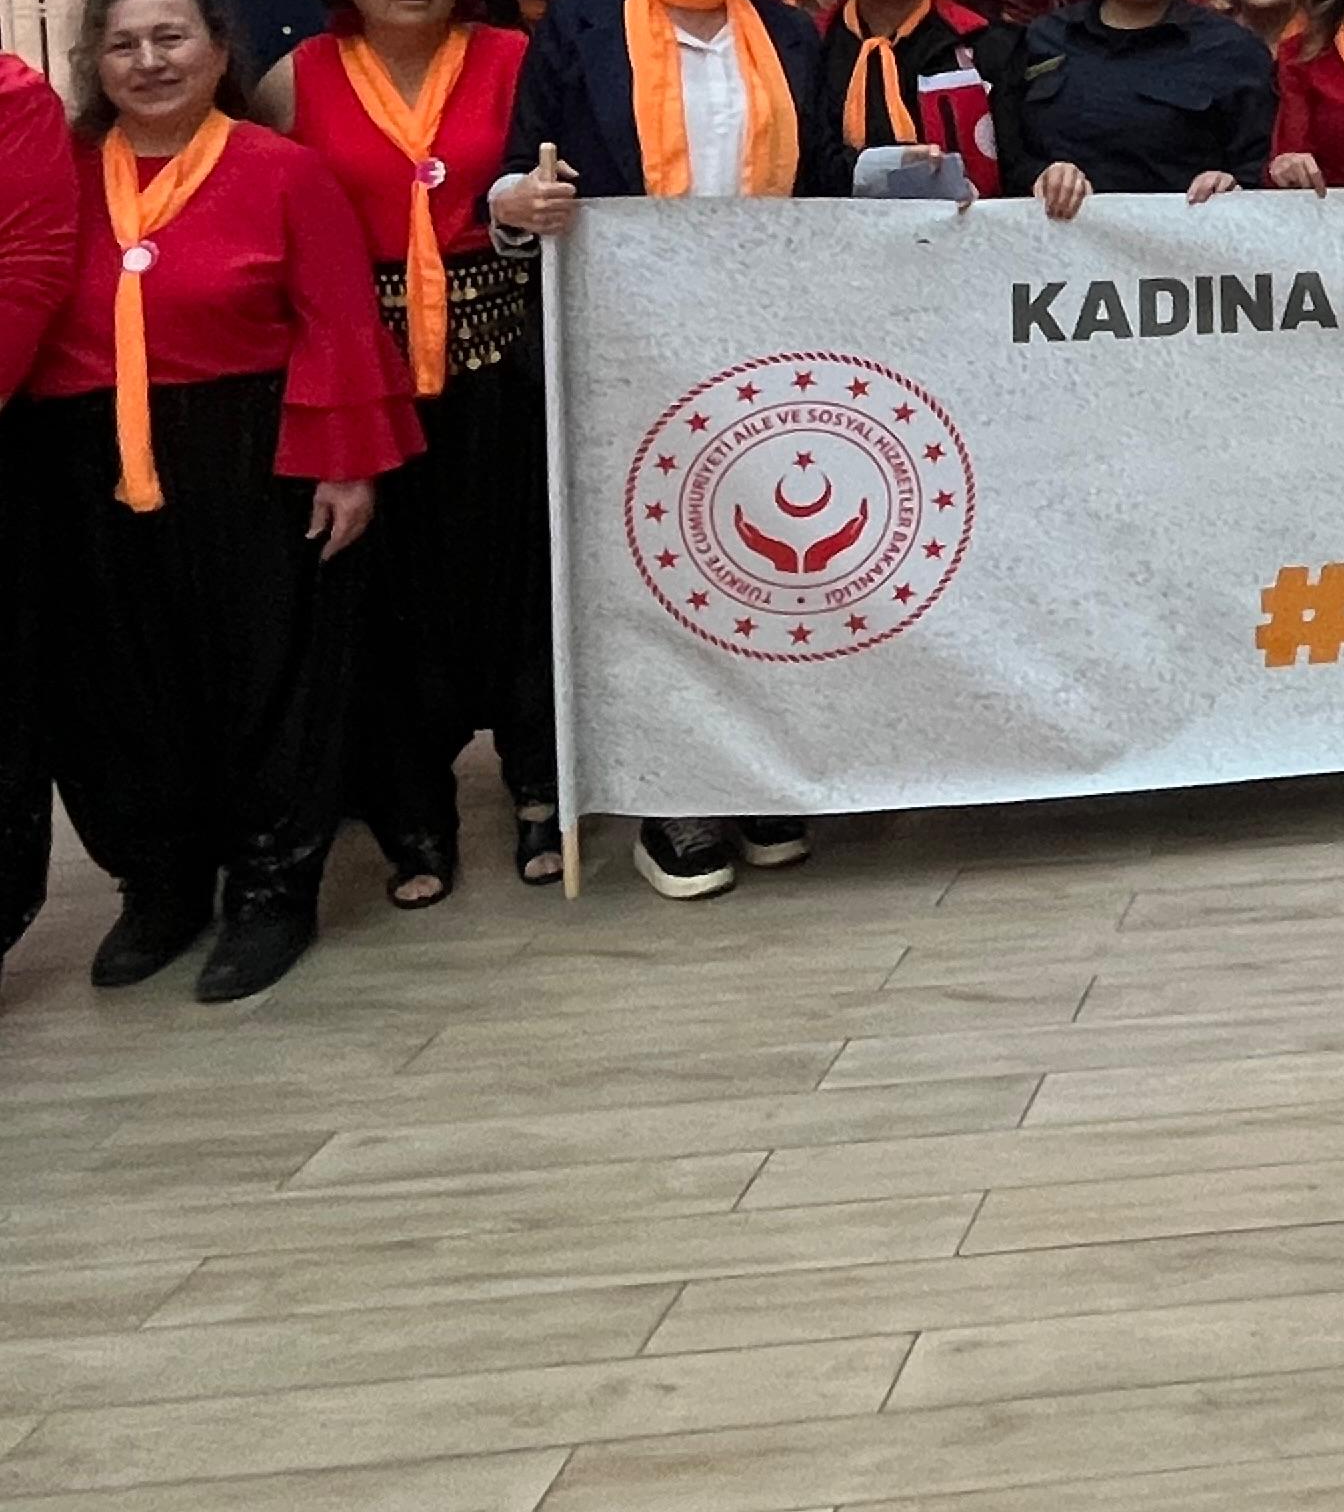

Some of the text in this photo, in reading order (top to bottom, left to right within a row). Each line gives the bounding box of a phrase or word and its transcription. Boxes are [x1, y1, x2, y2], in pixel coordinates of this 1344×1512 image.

[1012, 271, 1339, 343] KADINA
[776, 409, 802, 426] VE
[806, 407, 874, 442] SOSYAL
